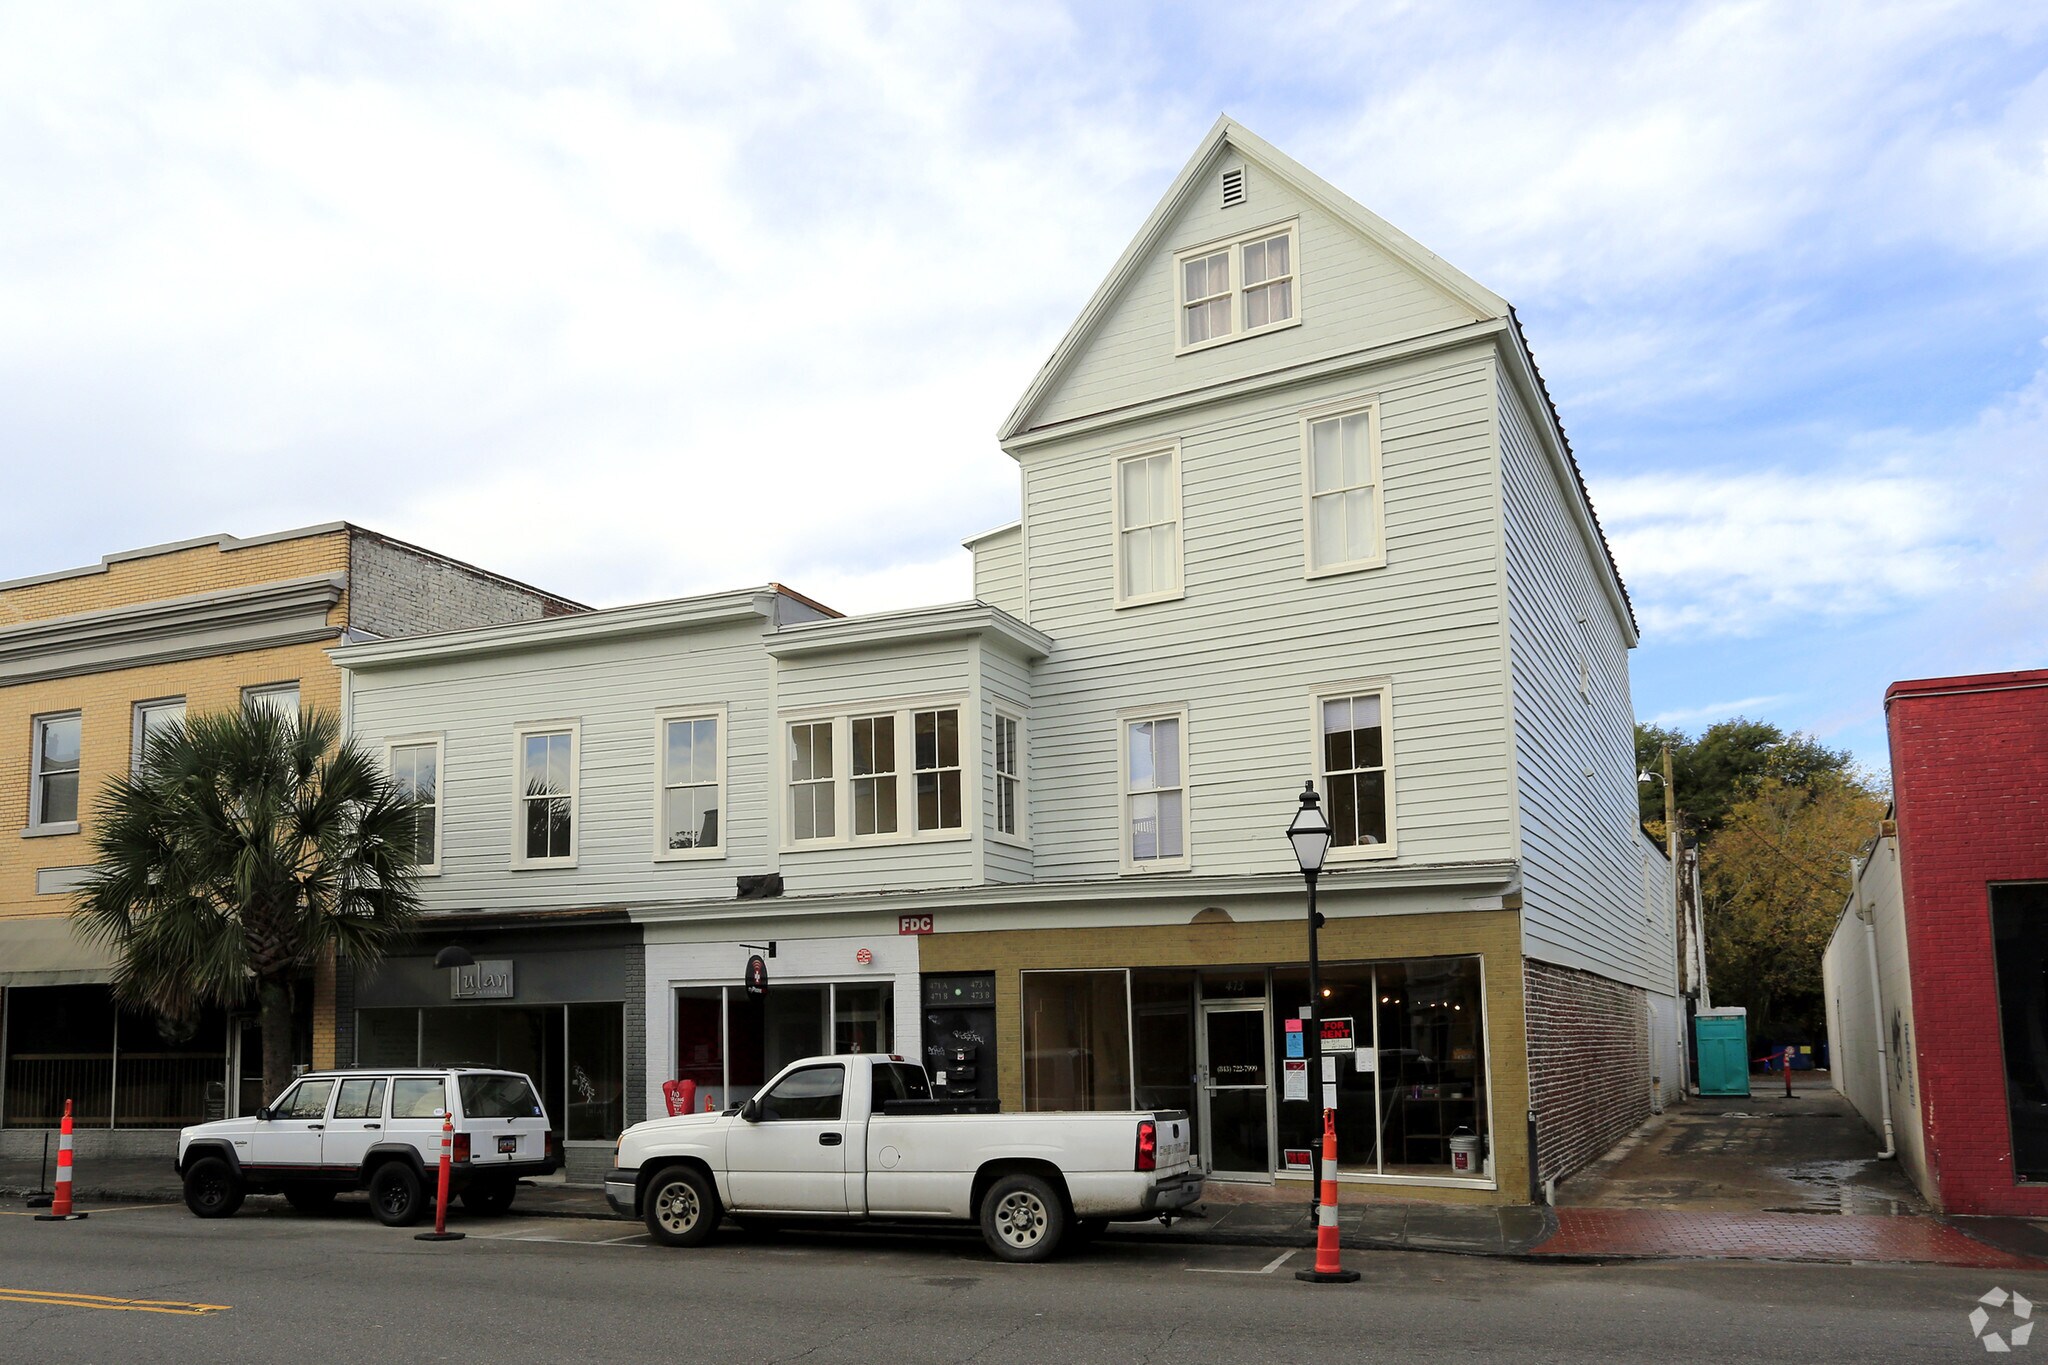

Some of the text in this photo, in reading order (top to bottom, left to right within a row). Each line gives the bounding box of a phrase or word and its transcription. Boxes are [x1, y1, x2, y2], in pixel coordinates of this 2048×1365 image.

[901, 917, 931, 932] FDC
[454, 963, 509, 998] Lulan
[970, 980, 983, 988] 473
[971, 991, 983, 1000] 473
[1324, 1021, 1345, 1030] FOR
[1320, 1029, 1351, 1039] RENT
